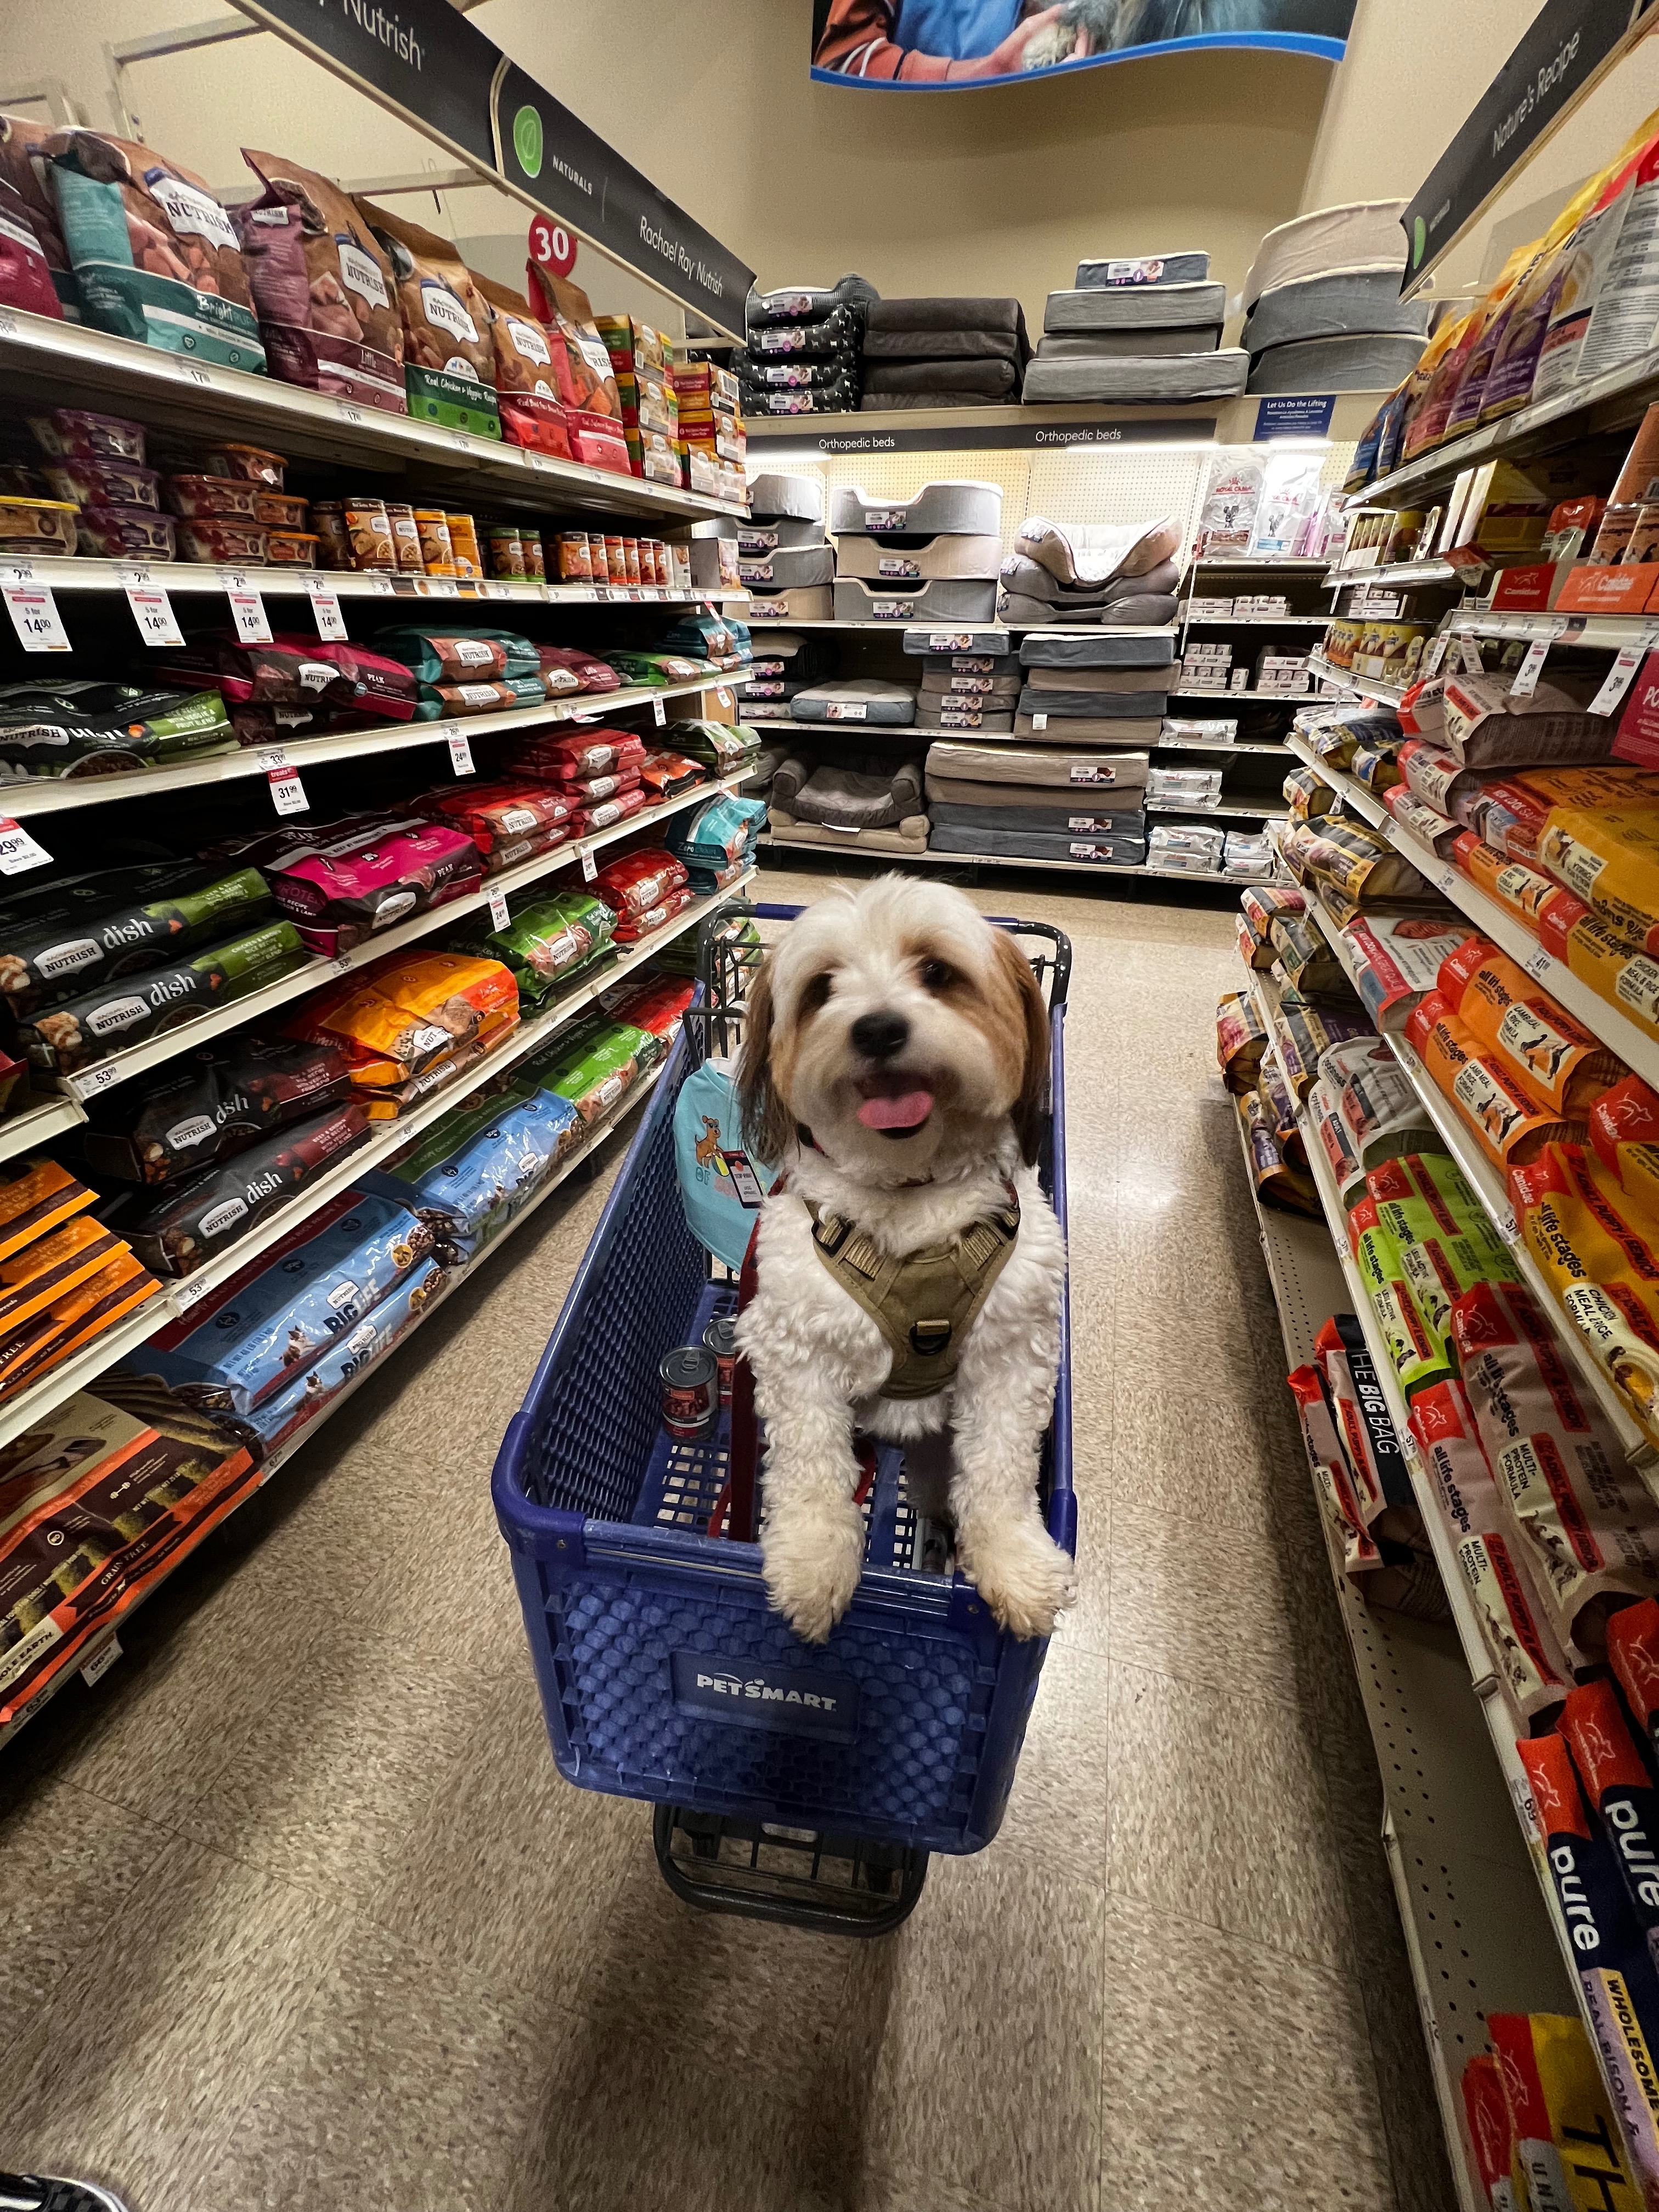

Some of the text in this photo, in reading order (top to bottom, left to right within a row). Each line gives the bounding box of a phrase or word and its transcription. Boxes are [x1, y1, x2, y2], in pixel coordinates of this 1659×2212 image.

[344, 0, 422, 71] Nutrish
[1493, 30, 1581, 157] Nature's Recipe
[552, 155, 592, 195] NATURALS
[535, 227, 569, 261] 30
[640, 216, 723, 297] Rachael Ray Nutrish
[819, 436, 895, 450] Orthopedic beds
[1035, 428, 1121, 443] Orthopedic beds
[104, 918, 154, 949] dish
[45, 947, 97, 972] NUTRISH
[150, 974, 196, 1006] dish
[97, 1005, 144, 1031] NUTRISH
[421, 1063, 449, 1087] NUTRISH
[173, 1123, 211, 1144] NUTRISH
[246, 1172, 283, 1204] dish
[1512, 1169, 1534, 1204] Canidae
[205, 1205, 244, 1233] NUTRISH
[1398, 1218, 1415, 1245] stages
[1369, 1255, 1384, 1284] stages
[1550, 1233, 1587, 1278] stages
[1573, 1289, 1596, 1316] MEAL
[1455, 1310, 1473, 1353] Canidae
[1359, 1384, 1400, 1454] BIG BAG
[1503, 1454, 1521, 1500] FORMULA
[1510, 1448, 1530, 1489] PROTEIN
[1519, 1443, 1537, 1477] MULTI-
[1434, 1446, 1471, 1533] all life stages
[101, 1561, 123, 1585] GRAIN
[1463, 1543, 1481, 1585] PROTEIN
[1471, 1541, 1487, 1572] MULTI-
[21, 1632, 53, 1659] EARTH
[697, 1673, 837, 1712] PETSMART
[1605, 1800, 1659, 1906] pure
[1550, 1846, 1600, 1951] pure
[1607, 1979, 1659, 2111] WHOLESOME
[1602, 2041, 1632, 2113] BISON
